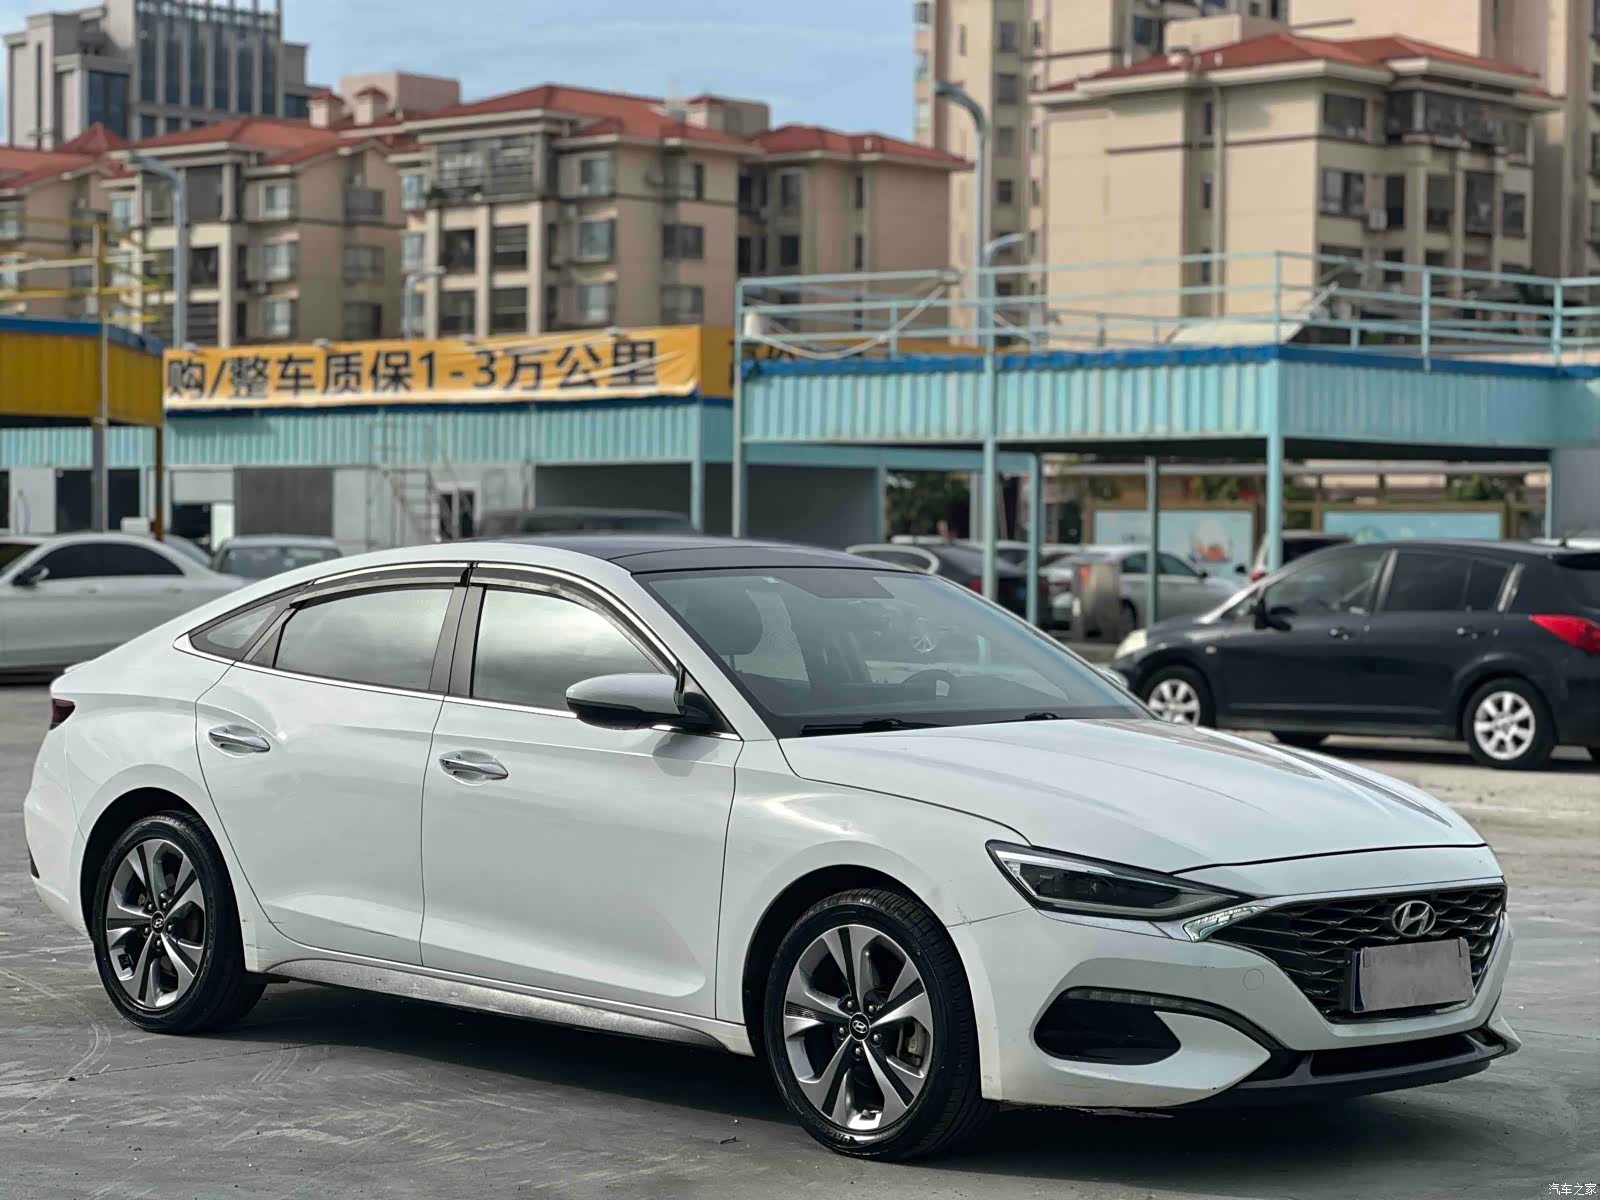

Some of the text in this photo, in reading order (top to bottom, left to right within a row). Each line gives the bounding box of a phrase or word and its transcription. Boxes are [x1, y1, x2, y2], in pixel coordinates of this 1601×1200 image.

[168, 341, 657, 399] 购/整车质保1-3万公里
